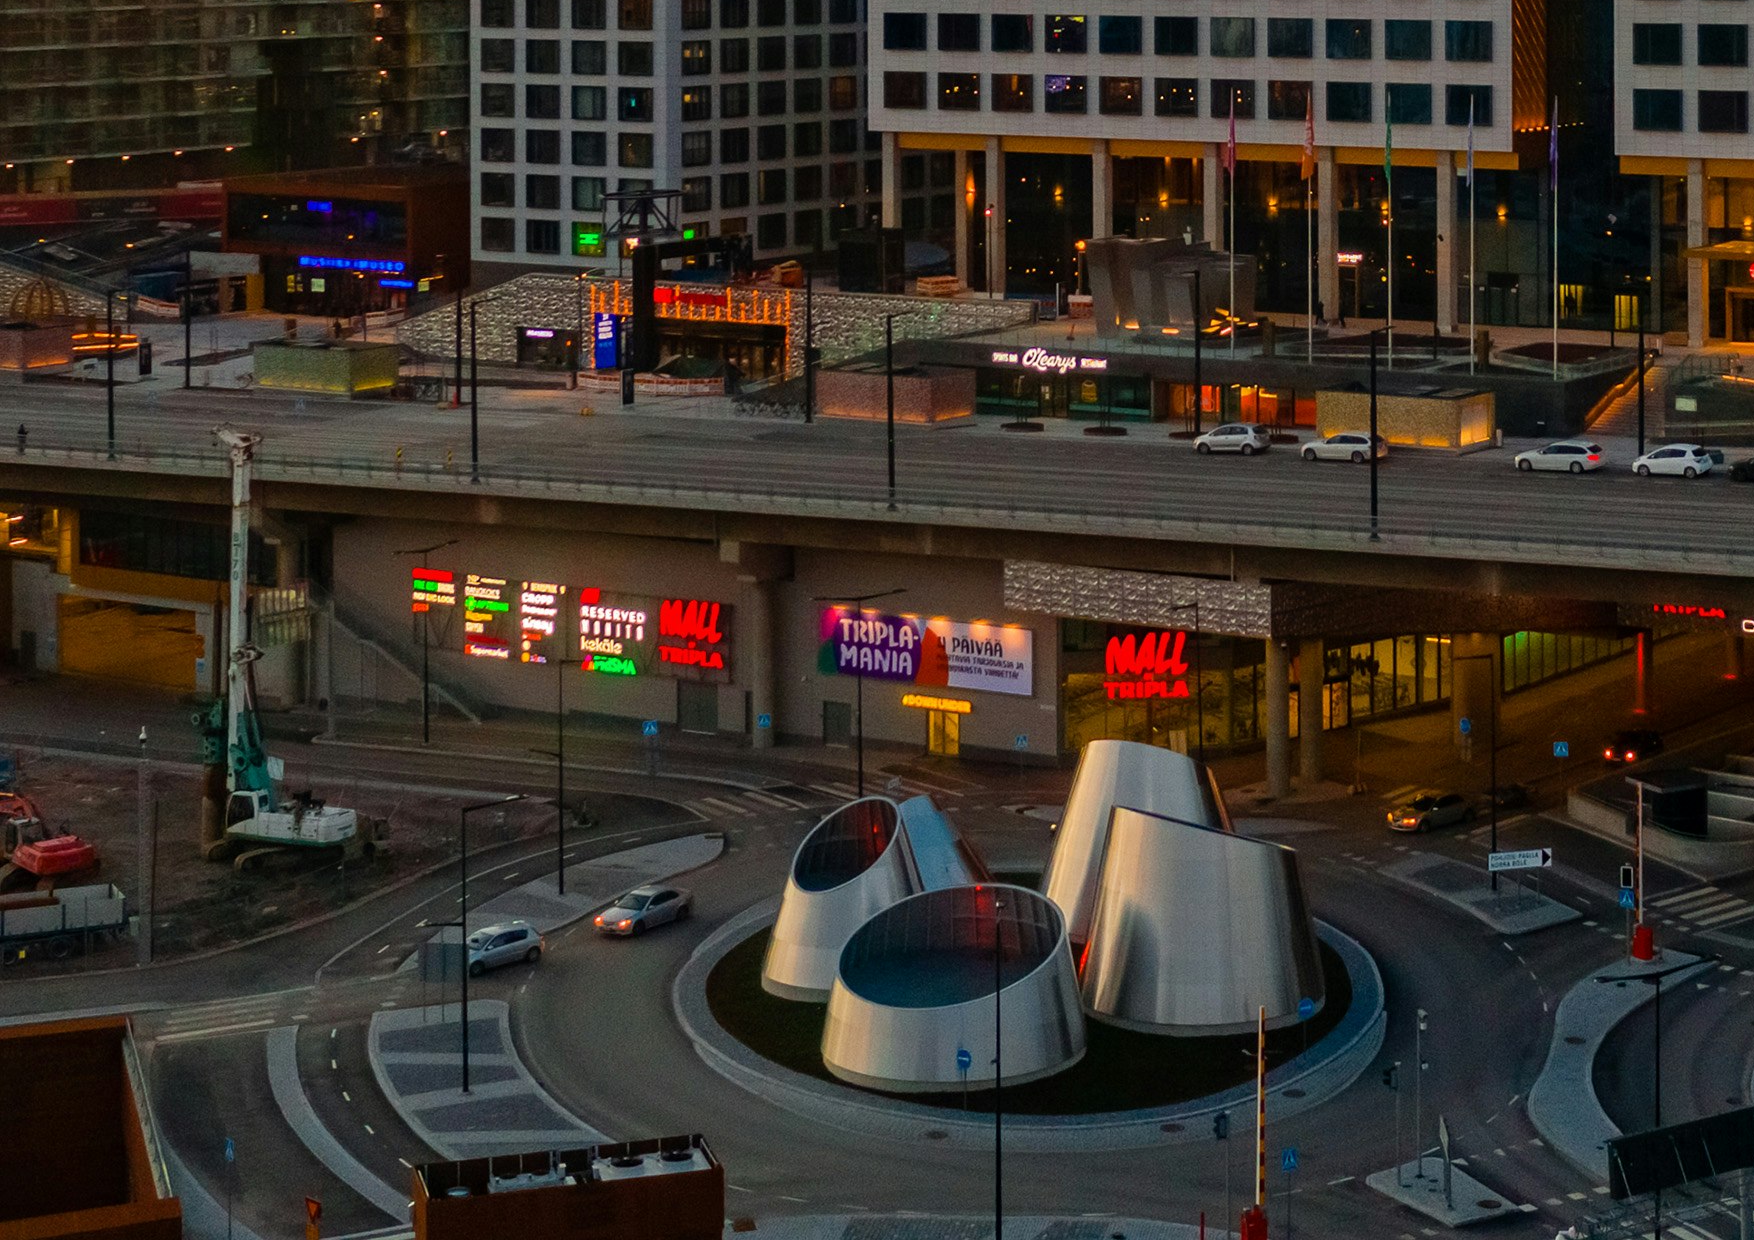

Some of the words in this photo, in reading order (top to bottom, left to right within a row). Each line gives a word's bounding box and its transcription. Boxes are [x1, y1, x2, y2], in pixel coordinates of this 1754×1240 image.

[1022, 347, 1077, 374] O'Learys
[580, 605, 646, 625] RESERVED
[659, 599, 723, 645] MALL
[580, 635, 623, 655] kekäle
[839, 618, 919, 650] TRIPLA-
[952, 635, 1003, 658] PÄIVÄÄ
[658, 645, 724, 670] TRIPLA
[840, 643, 913, 676] MANIA
[1105, 631, 1189, 675] MALL
[1103, 680, 1191, 699] TRIPLA
